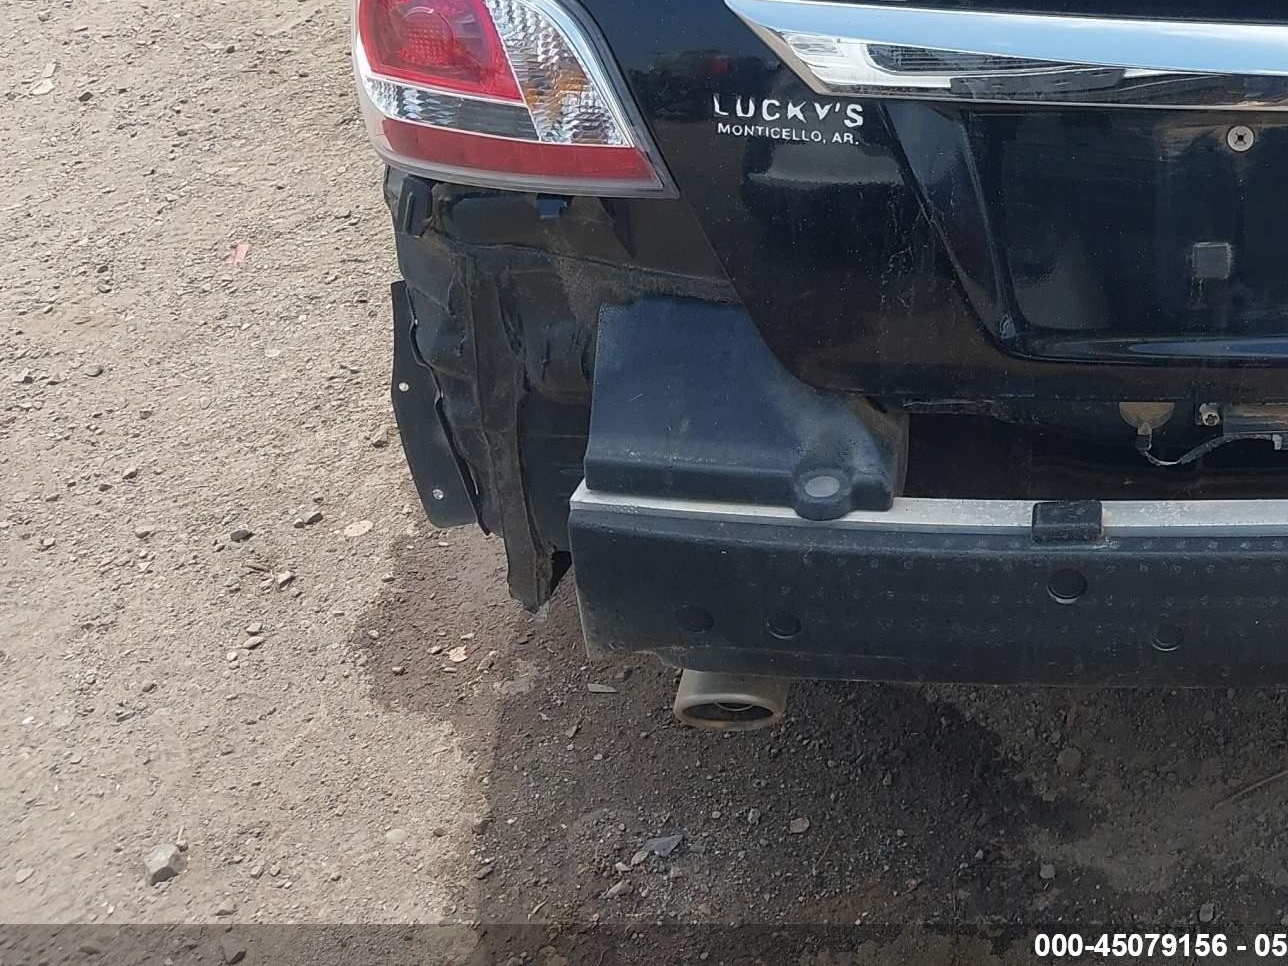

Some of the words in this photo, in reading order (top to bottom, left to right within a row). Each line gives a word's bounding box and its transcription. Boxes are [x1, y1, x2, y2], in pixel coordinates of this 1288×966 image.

[713, 93, 864, 128] LUCKY'S
[717, 122, 827, 144] MONTICELLO,
[831, 132, 860, 145] AR.
